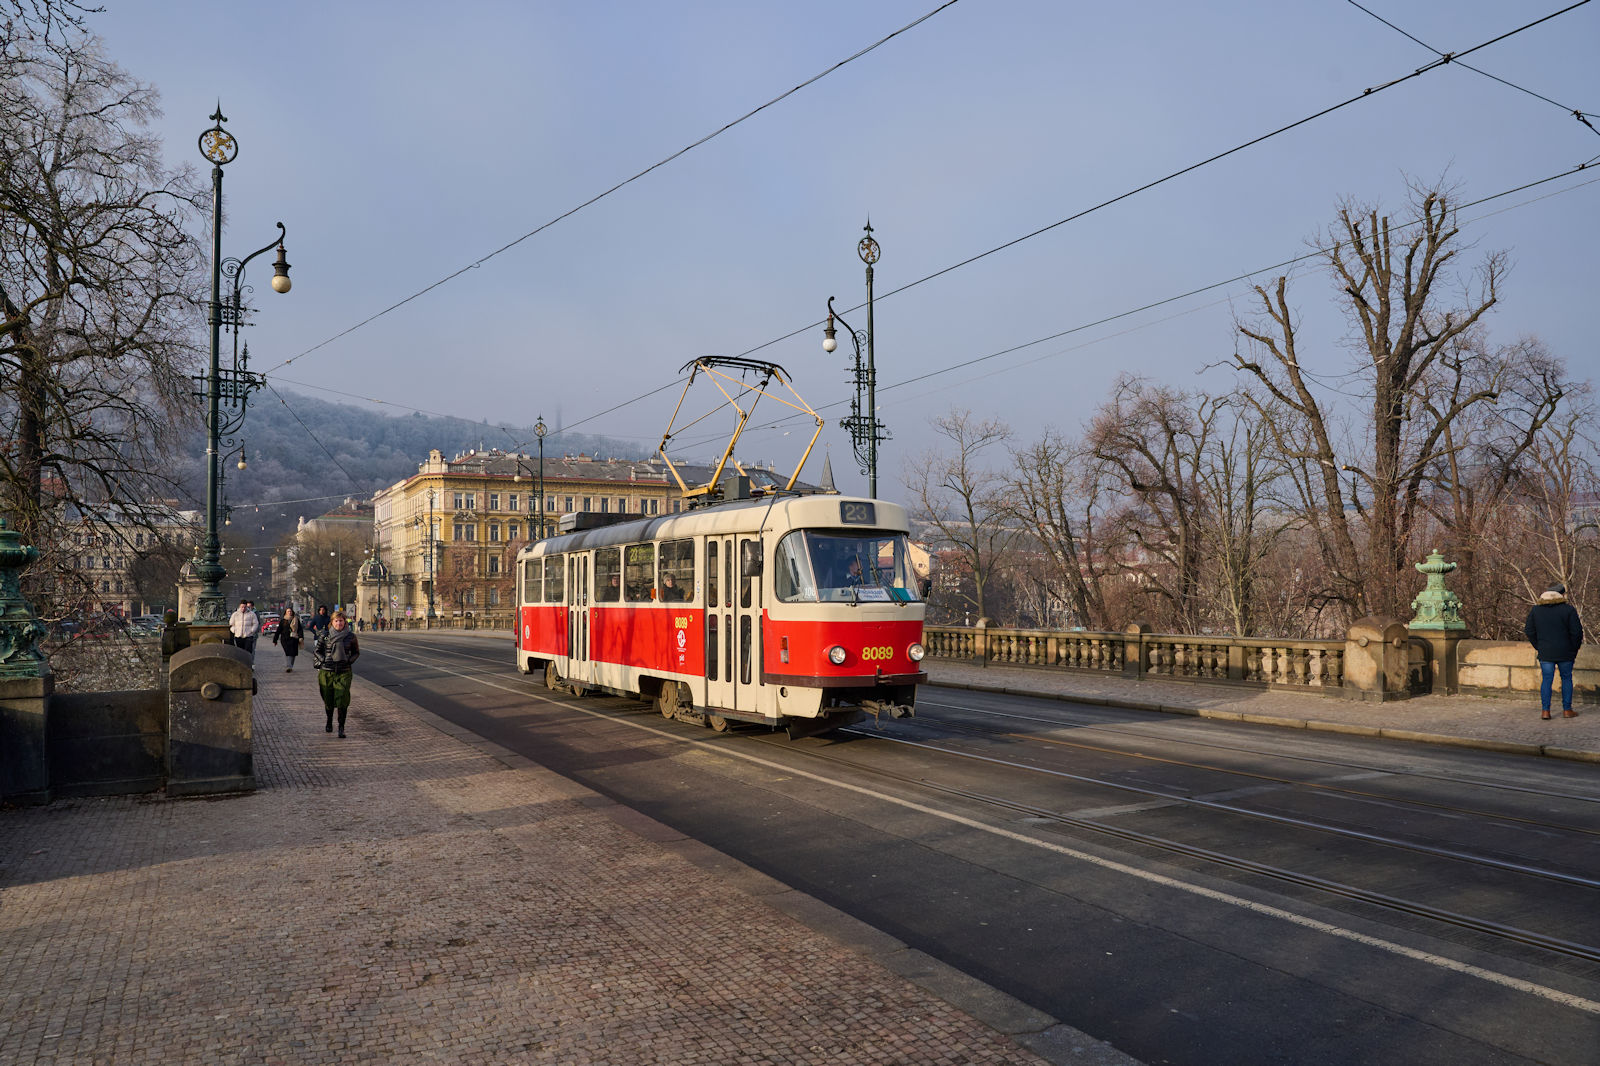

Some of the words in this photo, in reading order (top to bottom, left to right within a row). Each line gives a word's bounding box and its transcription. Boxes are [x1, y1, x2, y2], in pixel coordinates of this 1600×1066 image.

[845, 503, 867, 521] 23
[630, 547, 638, 562] 23
[675, 617, 688, 629] 8089
[862, 646, 894, 661] 8089
